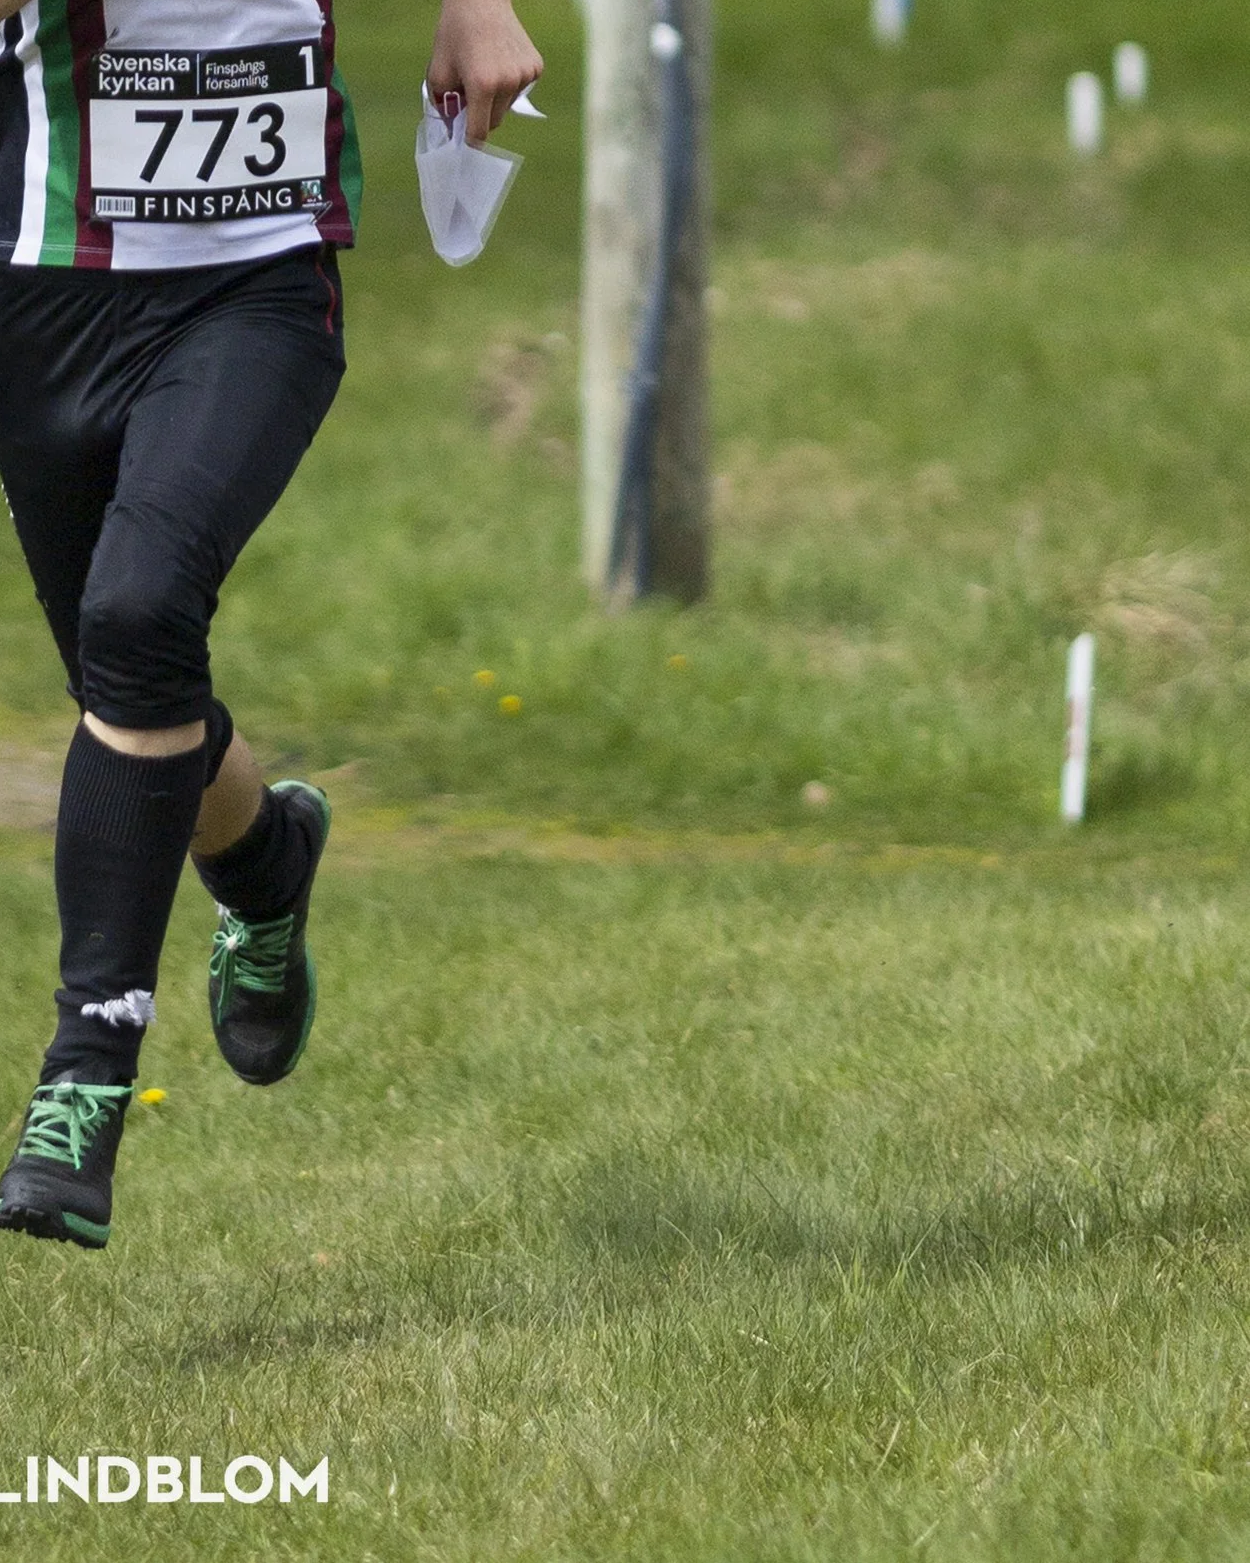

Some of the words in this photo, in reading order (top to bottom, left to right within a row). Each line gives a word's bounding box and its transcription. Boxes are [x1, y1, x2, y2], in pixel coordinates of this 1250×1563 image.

[98, 53, 191, 72] Svenska
[205, 60, 266, 76] Finspångs
[298, 45, 316, 87] 1
[98, 71, 175, 96] kyrkan
[205, 72, 269, 91] församling
[135, 102, 287, 183] 773
[144, 188, 293, 216] FINSPÅNG
